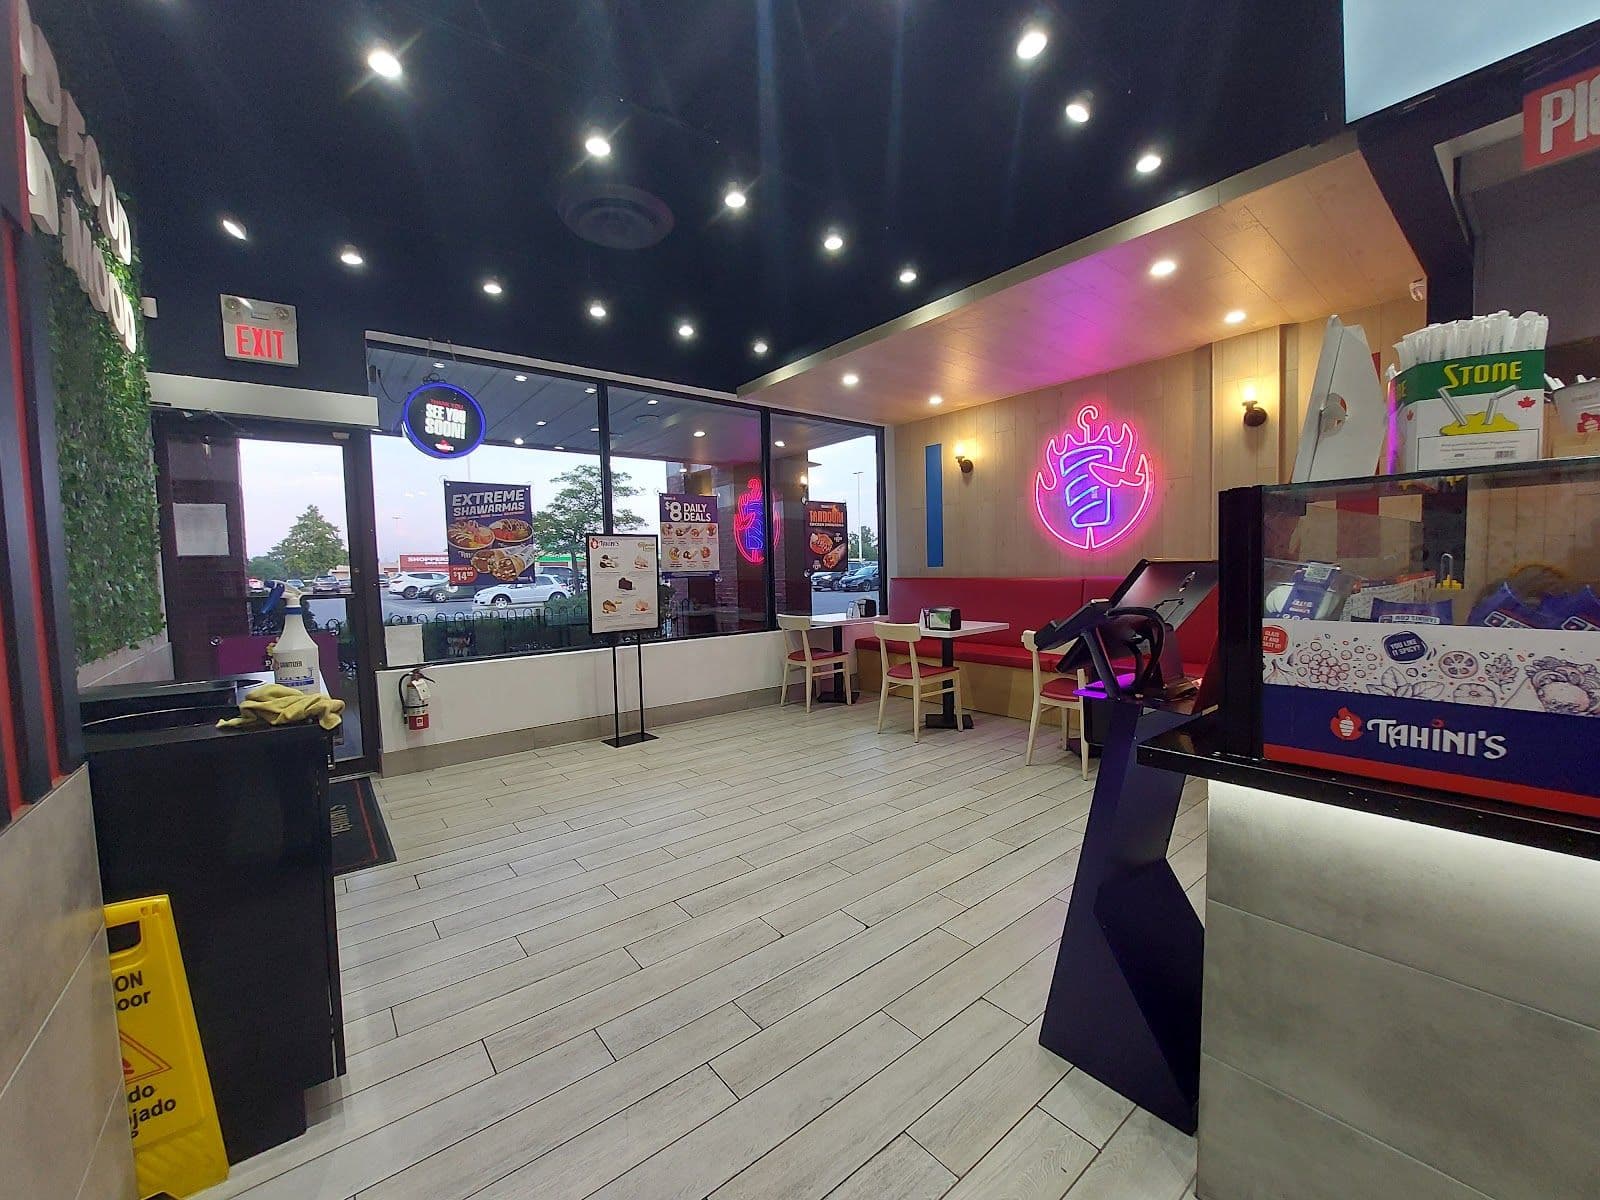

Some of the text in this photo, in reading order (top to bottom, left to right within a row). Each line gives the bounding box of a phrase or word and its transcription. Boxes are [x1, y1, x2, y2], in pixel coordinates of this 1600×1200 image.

[236, 323, 285, 360] EXIT
[425, 403, 466, 424] SEE YOU
[424, 417, 466, 440] SOON!
[452, 489, 525, 507] EXTREME
[683, 503, 708, 513] DAILY
[453, 501, 525, 517] SHAWARMAS
[683, 512, 712, 522] DEALS
[1367, 717, 1508, 760] TAHINI'S
[113, 970, 143, 992] ON
[116, 990, 151, 1011] oor
[128, 1083, 155, 1104] do
